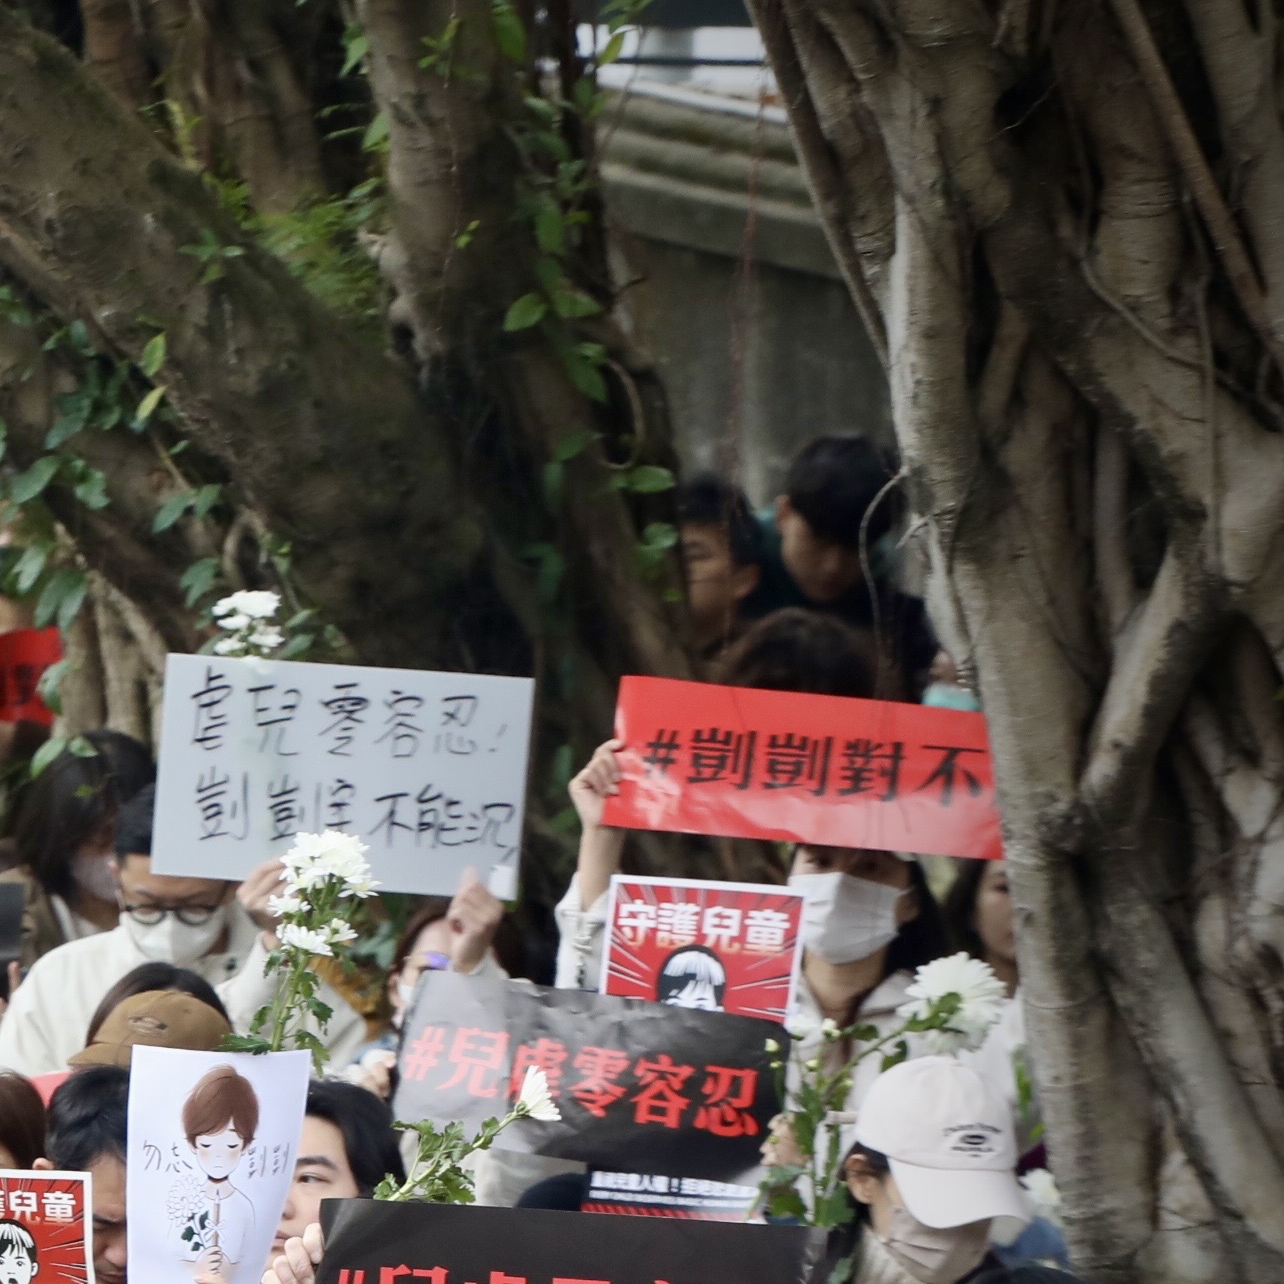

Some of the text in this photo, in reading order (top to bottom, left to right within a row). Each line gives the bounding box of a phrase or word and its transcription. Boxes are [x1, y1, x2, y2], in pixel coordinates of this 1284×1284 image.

[642, 726, 989, 808] #剴剴對不
[617, 899, 792, 957] 守護兒童
[405, 1025, 761, 1137] #兒虐零容忍
